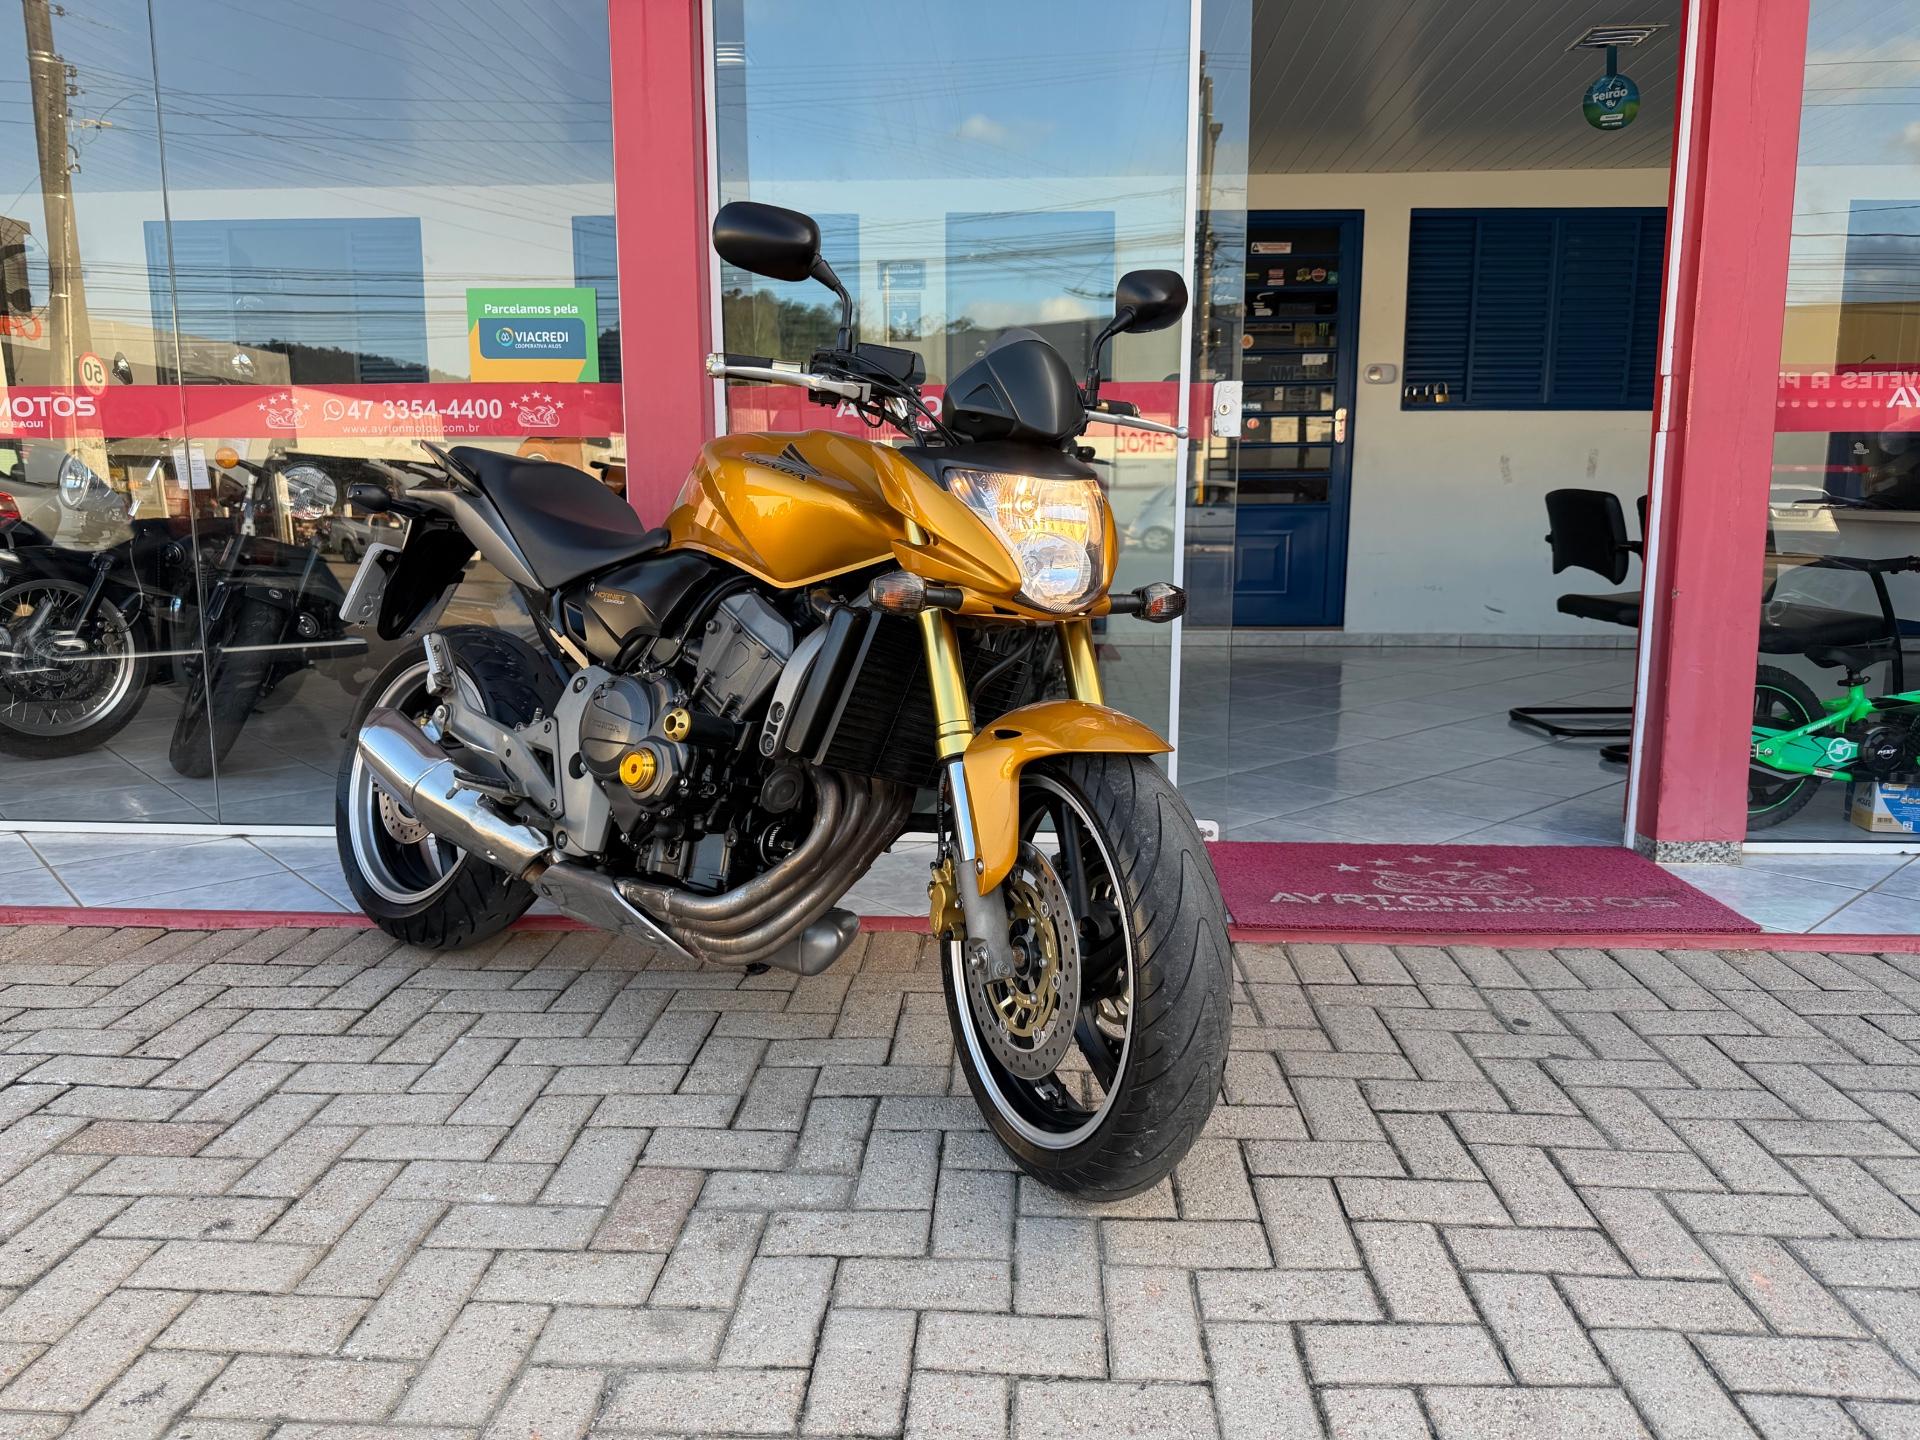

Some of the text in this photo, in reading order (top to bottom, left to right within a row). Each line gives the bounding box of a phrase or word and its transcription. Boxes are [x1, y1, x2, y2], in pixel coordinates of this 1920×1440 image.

[1592, 87, 1628, 103] Feirão
[484, 303, 578, 316] Parcelamos pela
[515, 331, 569, 343] VIACREDI
[348, 399, 503, 419] 47 3354-4400
[19, 420, 44, 428] AQUI
[342, 423, 480, 435] www.ayrtonmotos.com.br
[1270, 892, 1682, 908] AYRTON MOTOS
